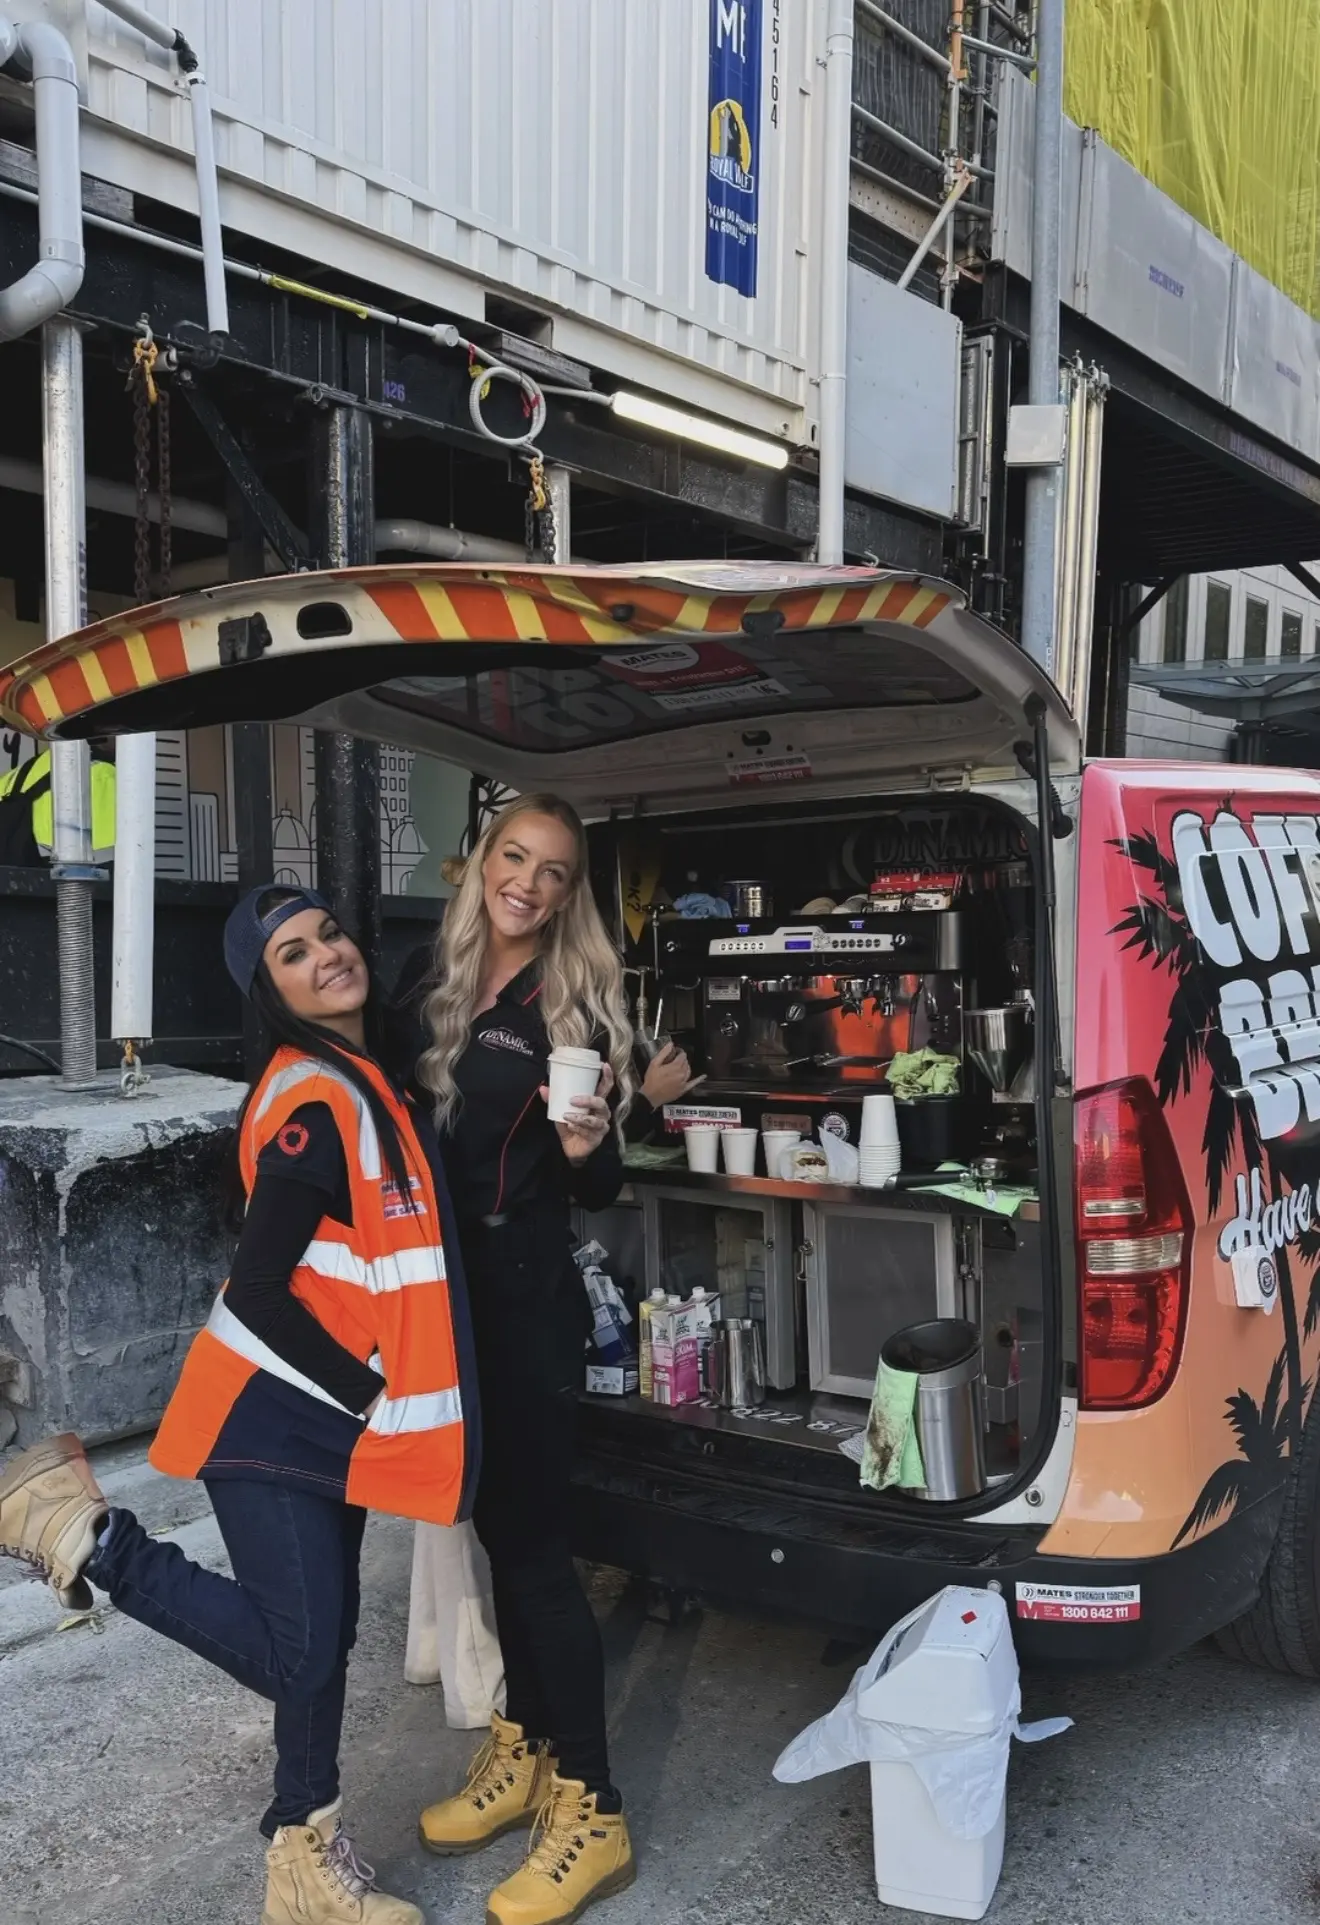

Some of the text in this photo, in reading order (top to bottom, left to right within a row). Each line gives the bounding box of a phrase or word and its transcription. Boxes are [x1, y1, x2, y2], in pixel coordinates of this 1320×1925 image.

[620, 650, 688, 667] MATES
[1220, 1167, 1313, 1257] Have
[1037, 1588, 1072, 1598] MATES
[1061, 1606, 1088, 1619] 1300
[1090, 1606, 1113, 1619] 642
[1115, 1606, 1129, 1619] 111
